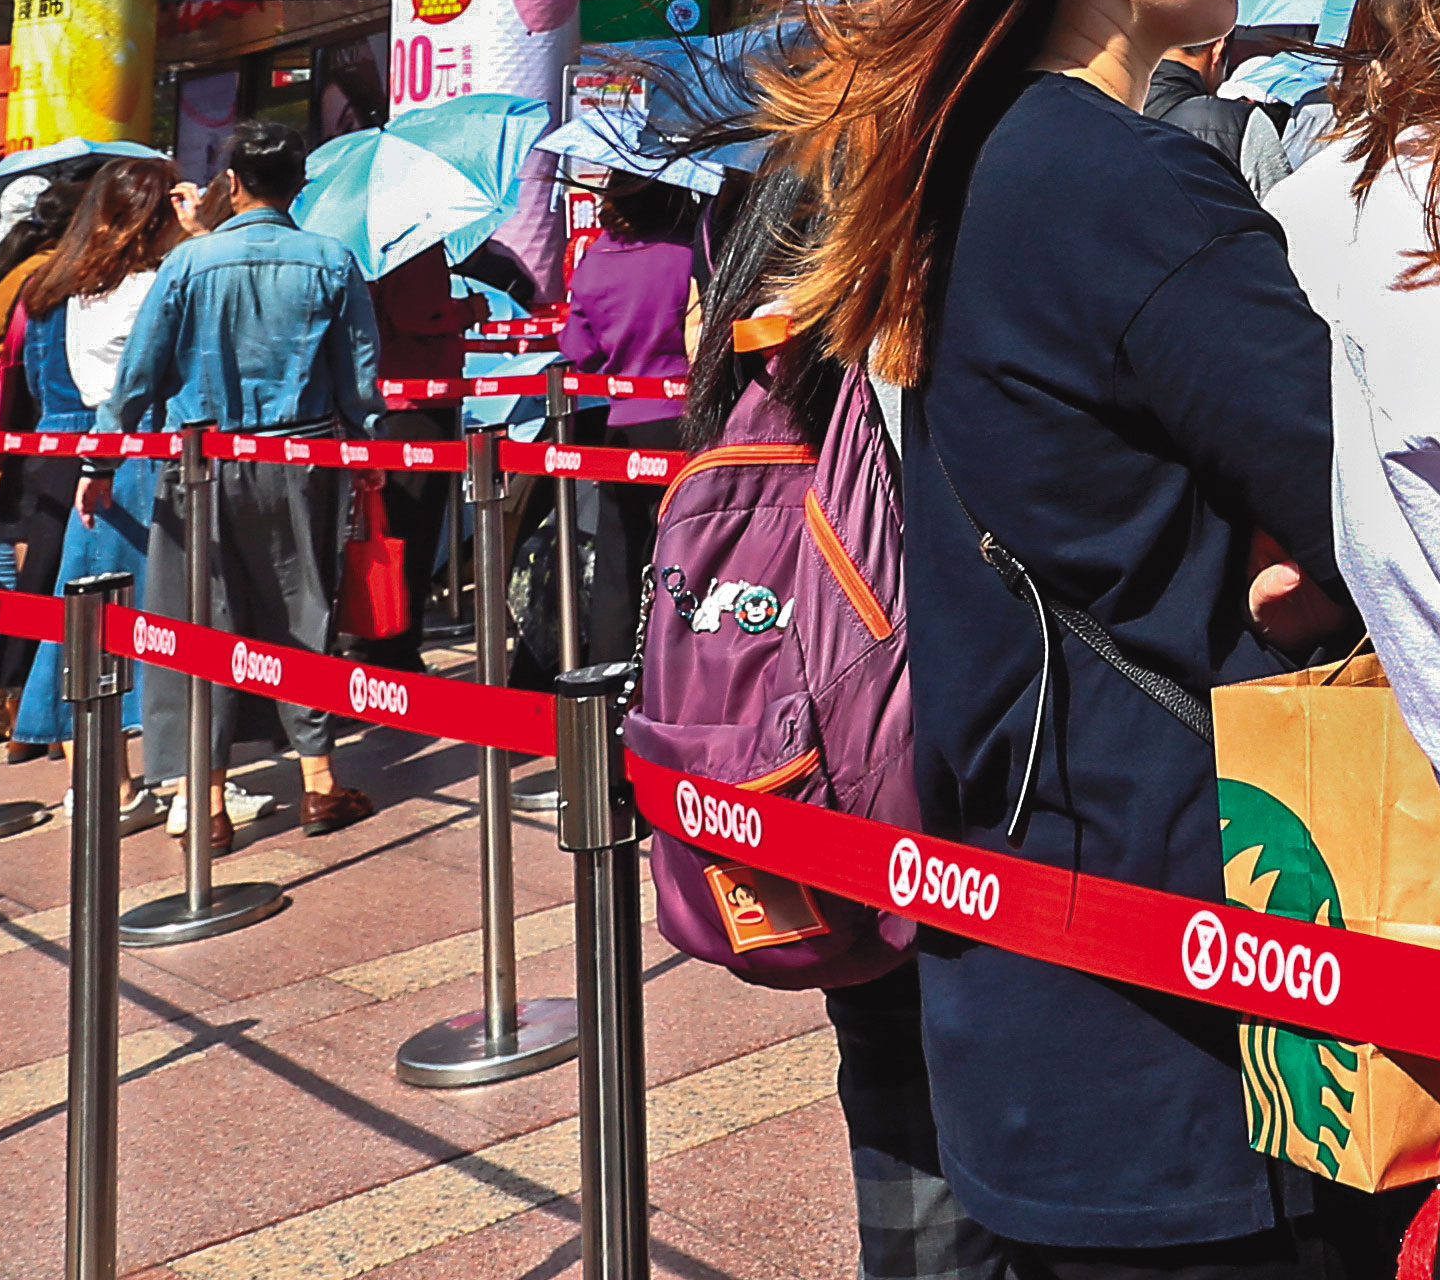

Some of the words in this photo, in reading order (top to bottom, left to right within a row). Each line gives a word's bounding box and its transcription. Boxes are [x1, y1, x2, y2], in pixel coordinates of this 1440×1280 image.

[556, 451, 582, 471] SOGO
[638, 455, 669, 478] SOGO
[145, 623, 177, 657] SOGO
[246, 650, 282, 687] SOGO
[367, 677, 409, 716] SOGO
[703, 794, 762, 848] SOGO
[922, 855, 1000, 921] SOGO
[1230, 930, 1342, 1007] SOGO
